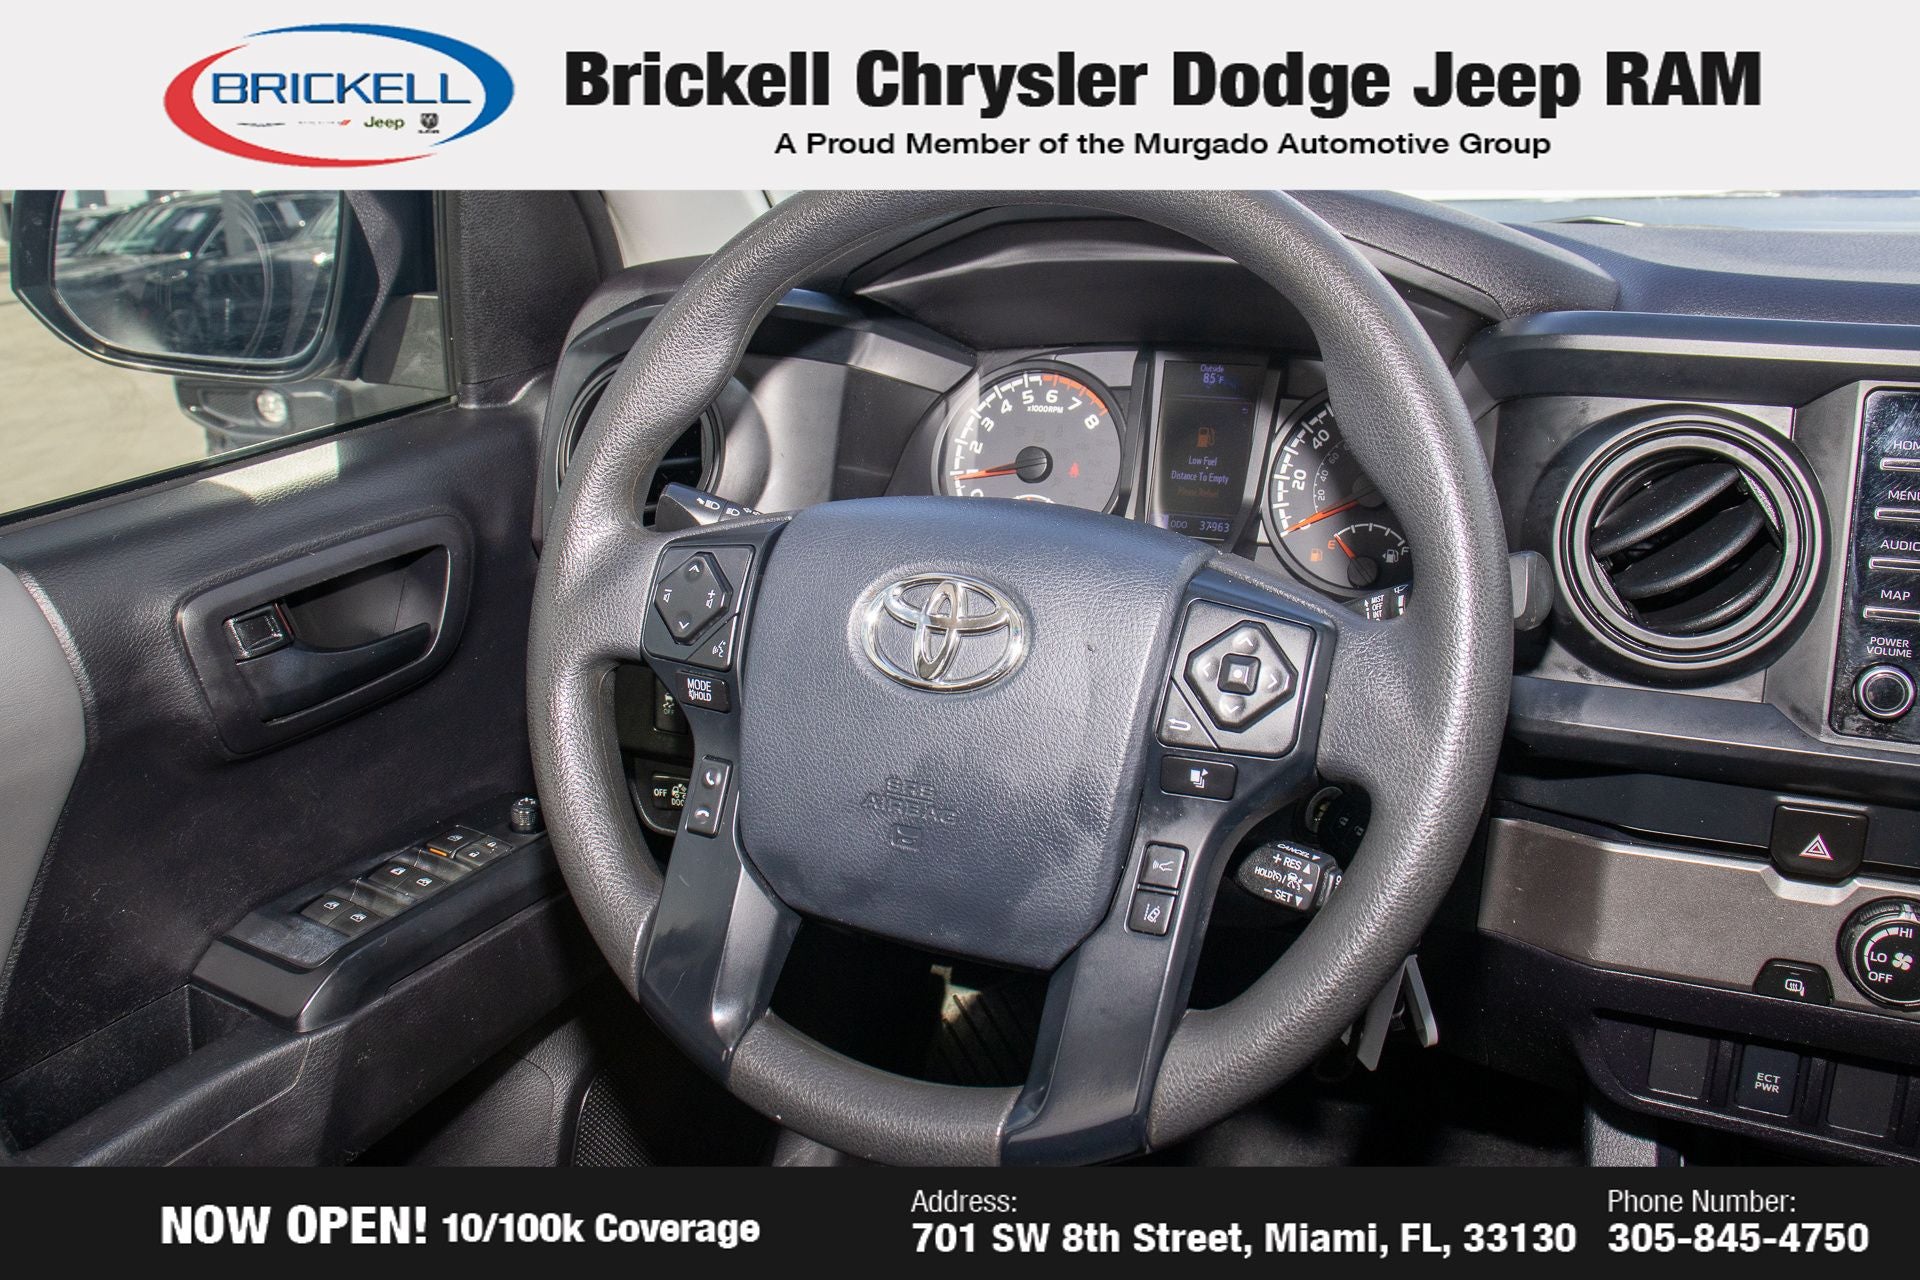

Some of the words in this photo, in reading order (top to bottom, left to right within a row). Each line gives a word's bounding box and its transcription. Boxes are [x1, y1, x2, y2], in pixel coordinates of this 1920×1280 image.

[1022, 390, 1034, 405] 5
[1046, 390, 1058, 403] 6
[1001, 399, 1013, 414] 4
[1067, 397, 1083, 411] 7
[980, 416, 995, 432] 3
[1084, 414, 1100, 430] 8
[1312, 429, 1330, 450] 40
[1893, 440, 1920, 451] HOM
[969, 440, 983, 454] 2
[1292, 469, 1307, 491] 20
[1200, 521, 1230, 533] 37963
[1327, 539, 1336, 550] E
[1880, 589, 1911, 601] MAP
[1870, 636, 1909, 648] POWER
[1866, 645, 1912, 658] VOLUME
[687, 678, 712, 693] MODE
[694, 690, 712, 702] HOLD
[653, 788, 668, 798] OFF
[1283, 856, 1302, 871] RES
[1254, 865, 1273, 879] HOLD
[1274, 889, 1294, 903] SET
[1899, 927, 1913, 939] HI
[1870, 951, 1888, 963] LO
[1868, 971, 1893, 984] OFF
[1756, 1072, 1781, 1084] ECT
[1754, 1081, 1780, 1094] PWR
